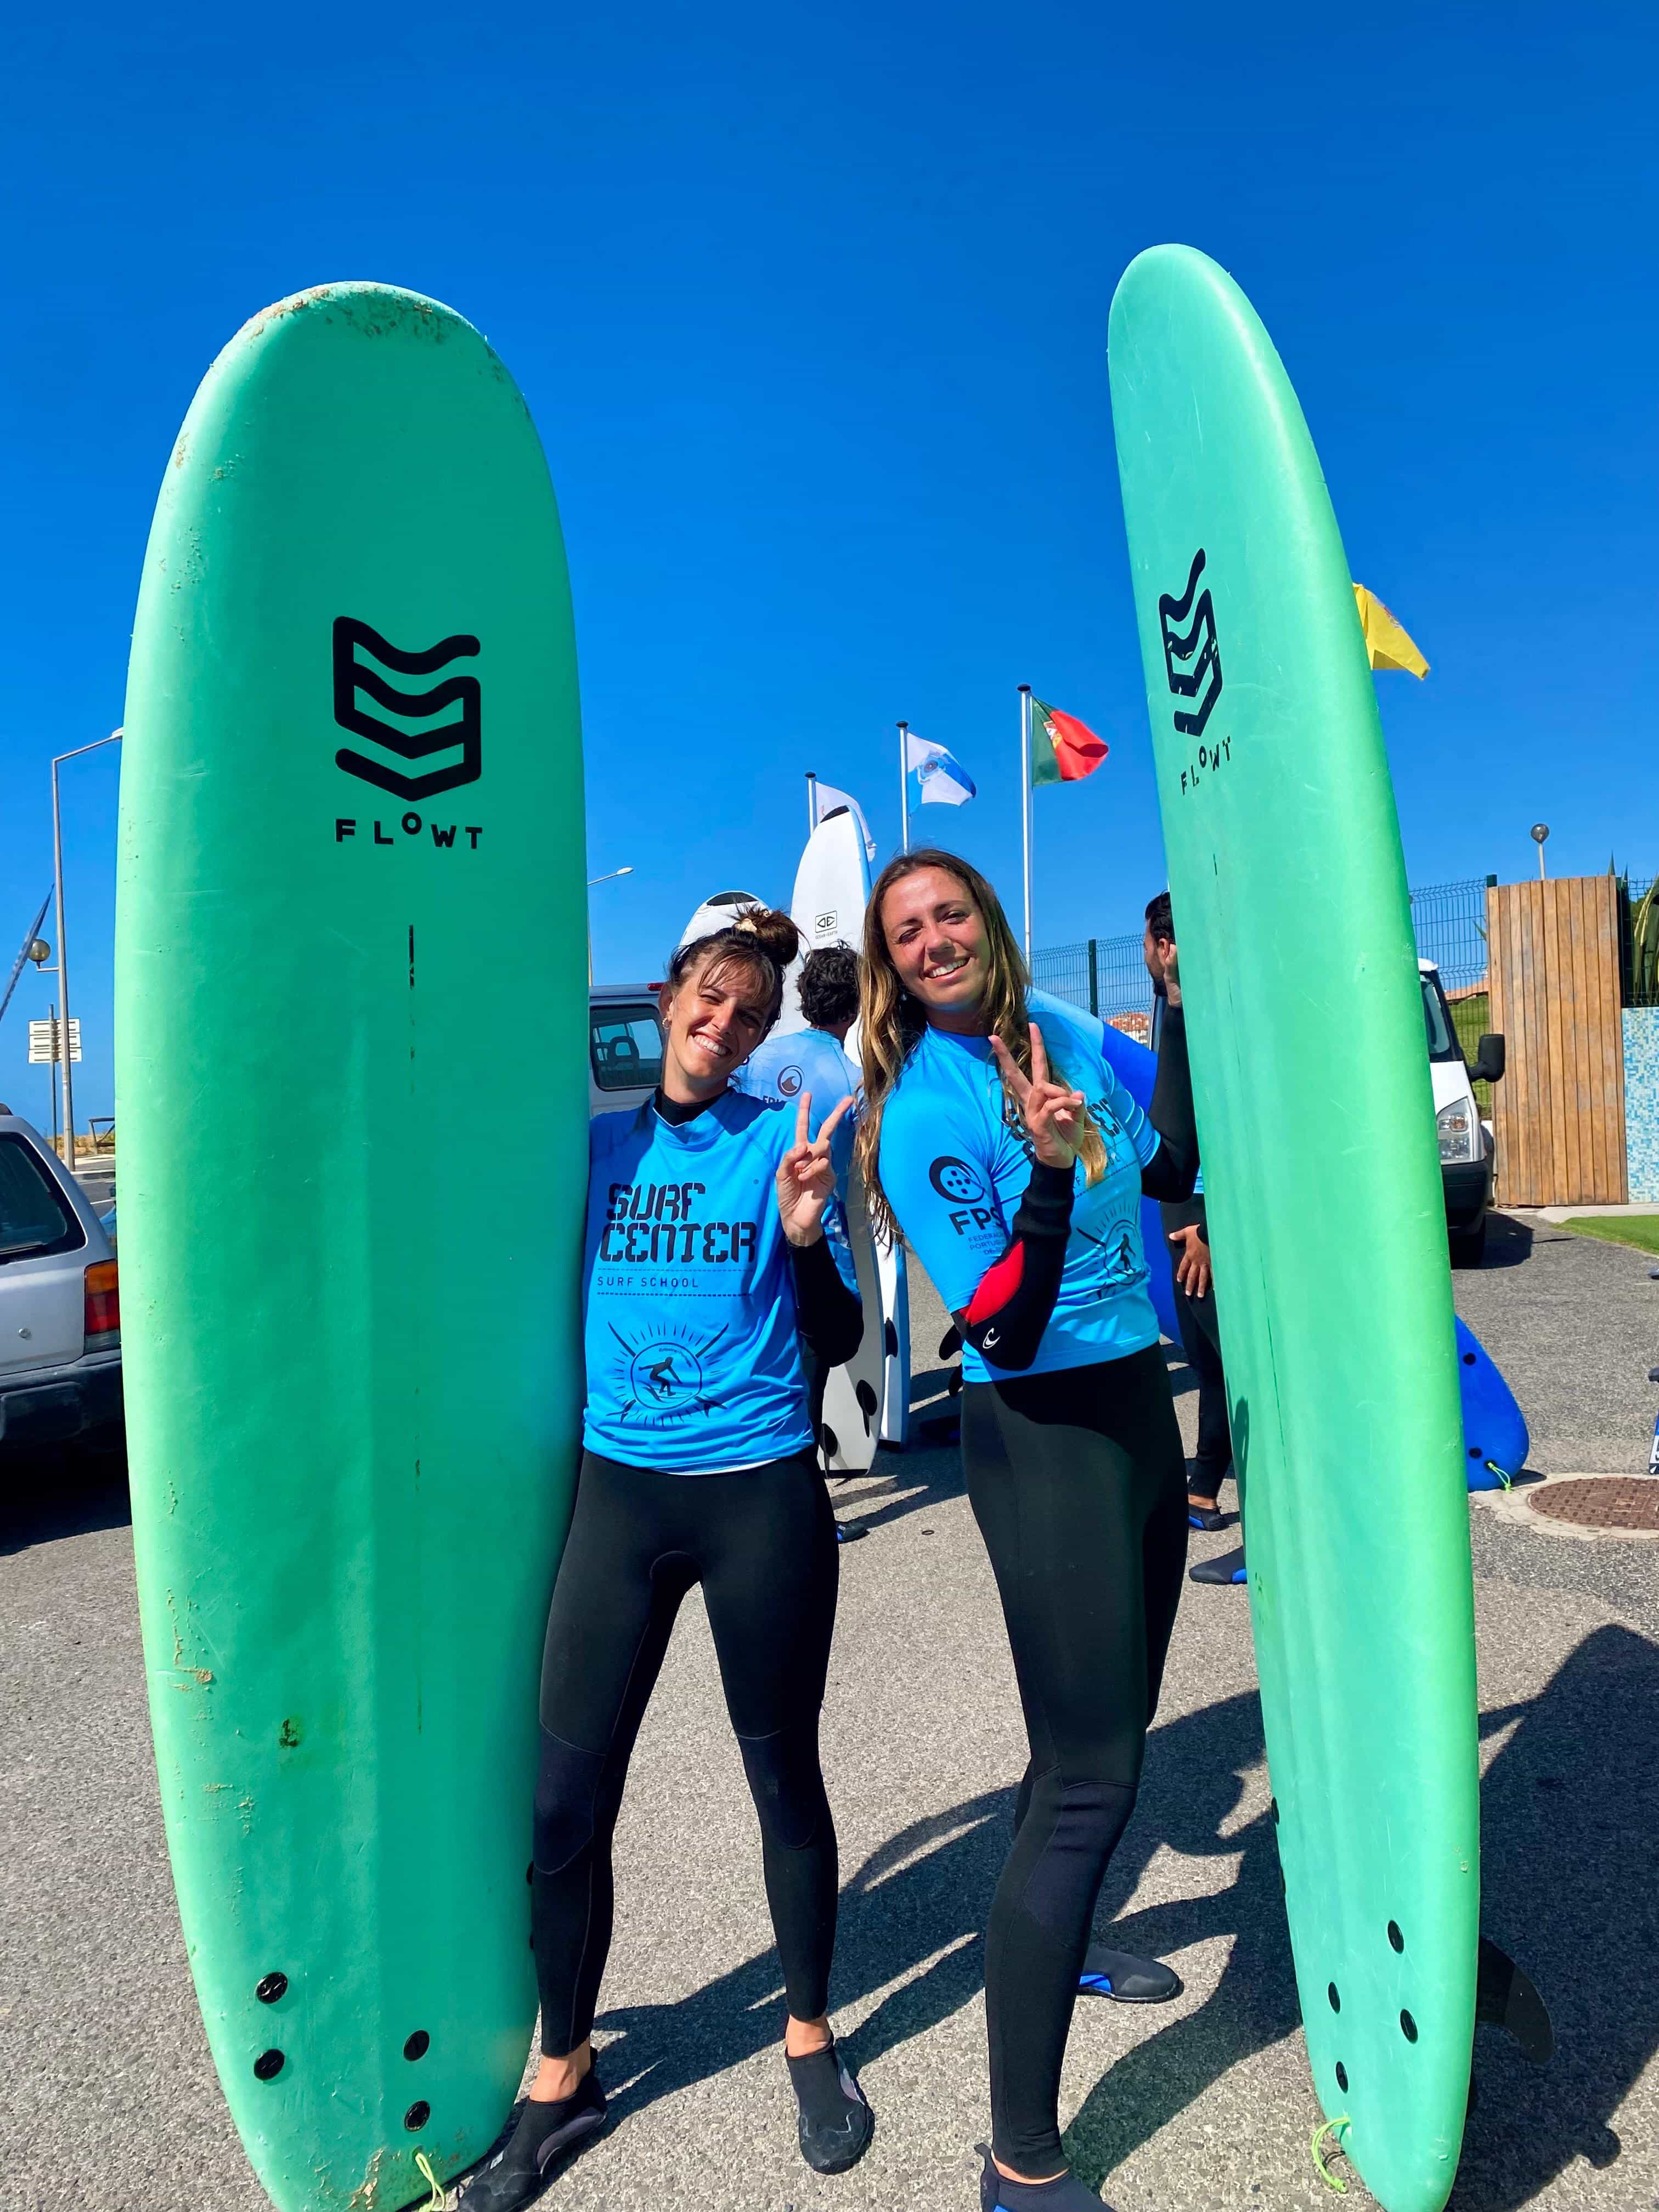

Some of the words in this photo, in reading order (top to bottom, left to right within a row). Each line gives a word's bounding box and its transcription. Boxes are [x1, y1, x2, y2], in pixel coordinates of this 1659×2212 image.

[1181, 735, 1231, 795] FLOWT
[336, 811, 483, 849] FLOWT
[606, 1182, 706, 1222] SURF
[600, 1221, 757, 1263] CENTER
[597, 1277, 634, 1286] SURF
[641, 1277, 698, 1288] SCHOOL
